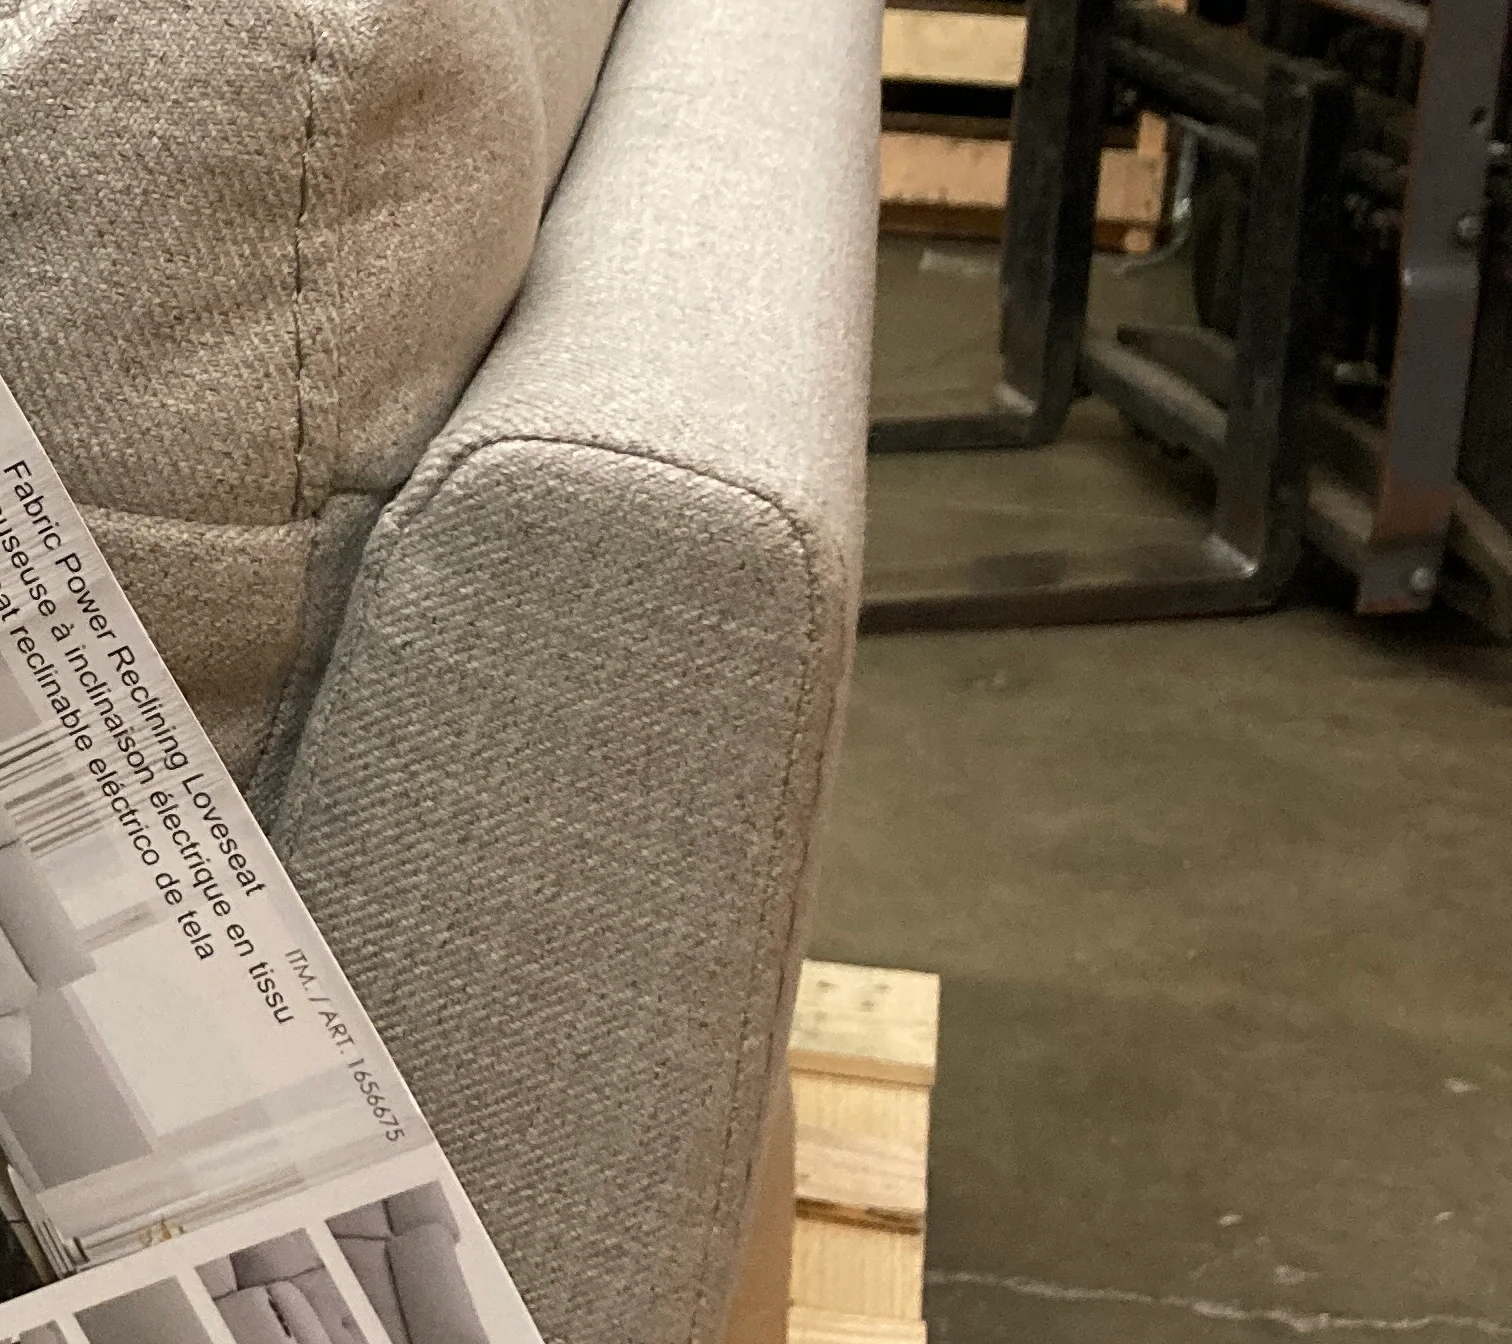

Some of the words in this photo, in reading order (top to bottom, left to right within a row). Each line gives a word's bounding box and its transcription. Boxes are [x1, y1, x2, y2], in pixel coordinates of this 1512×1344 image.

[2, 458, 66, 553] Fabric
[54, 551, 120, 643] Power
[104, 643, 192, 773] Reclining
[181, 771, 267, 898] Loveseat
[8, 622, 97, 754] reclinable
[86, 755, 164, 868] eléctrico
[153, 869, 187, 908] de
[176, 908, 218, 961] tela
[64, 642, 160, 787] inclinaison
[145, 787, 235, 920] électrique
[225, 921, 256, 959] en
[247, 960, 297, 1026] tissu
[284, 947, 319, 992] ITM.
[318, 1007, 356, 1054] ART.
[346, 1056, 406, 1144] 1656675
